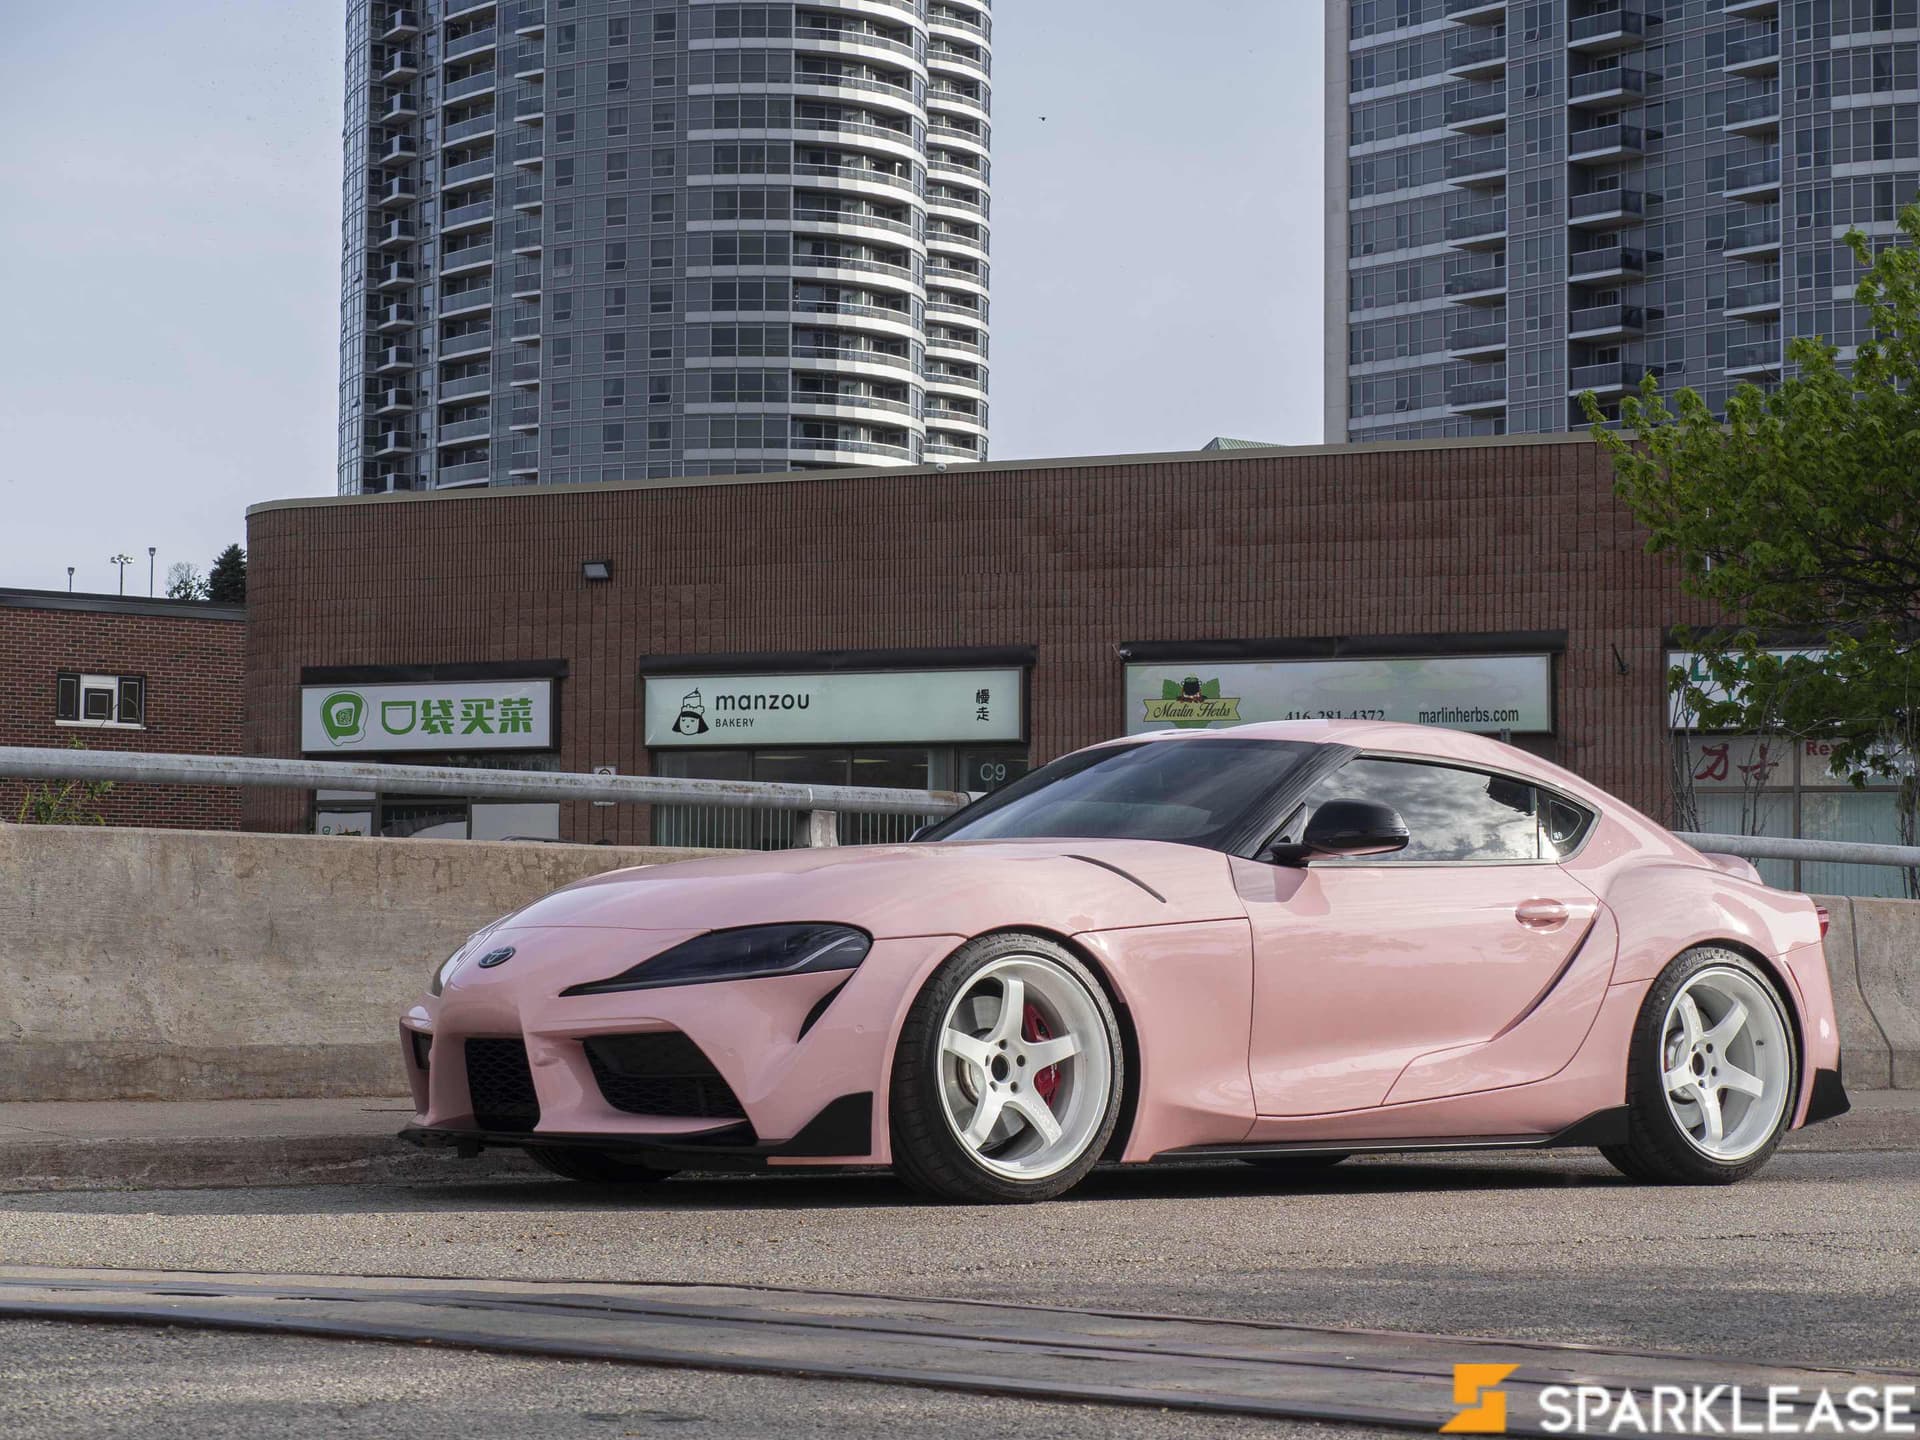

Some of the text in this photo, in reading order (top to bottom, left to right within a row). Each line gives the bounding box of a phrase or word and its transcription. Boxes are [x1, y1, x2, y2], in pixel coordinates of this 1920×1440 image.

[715, 693, 810, 711] manzou
[975, 688, 990, 721] 慢走
[1153, 702, 1231, 719] Marlin Herbs
[381, 698, 533, 735] 口袋买菜
[715, 718, 755, 728] BAKERY
[1418, 706, 1519, 724] marlinherbs.com
[980, 763, 1006, 781] C9
